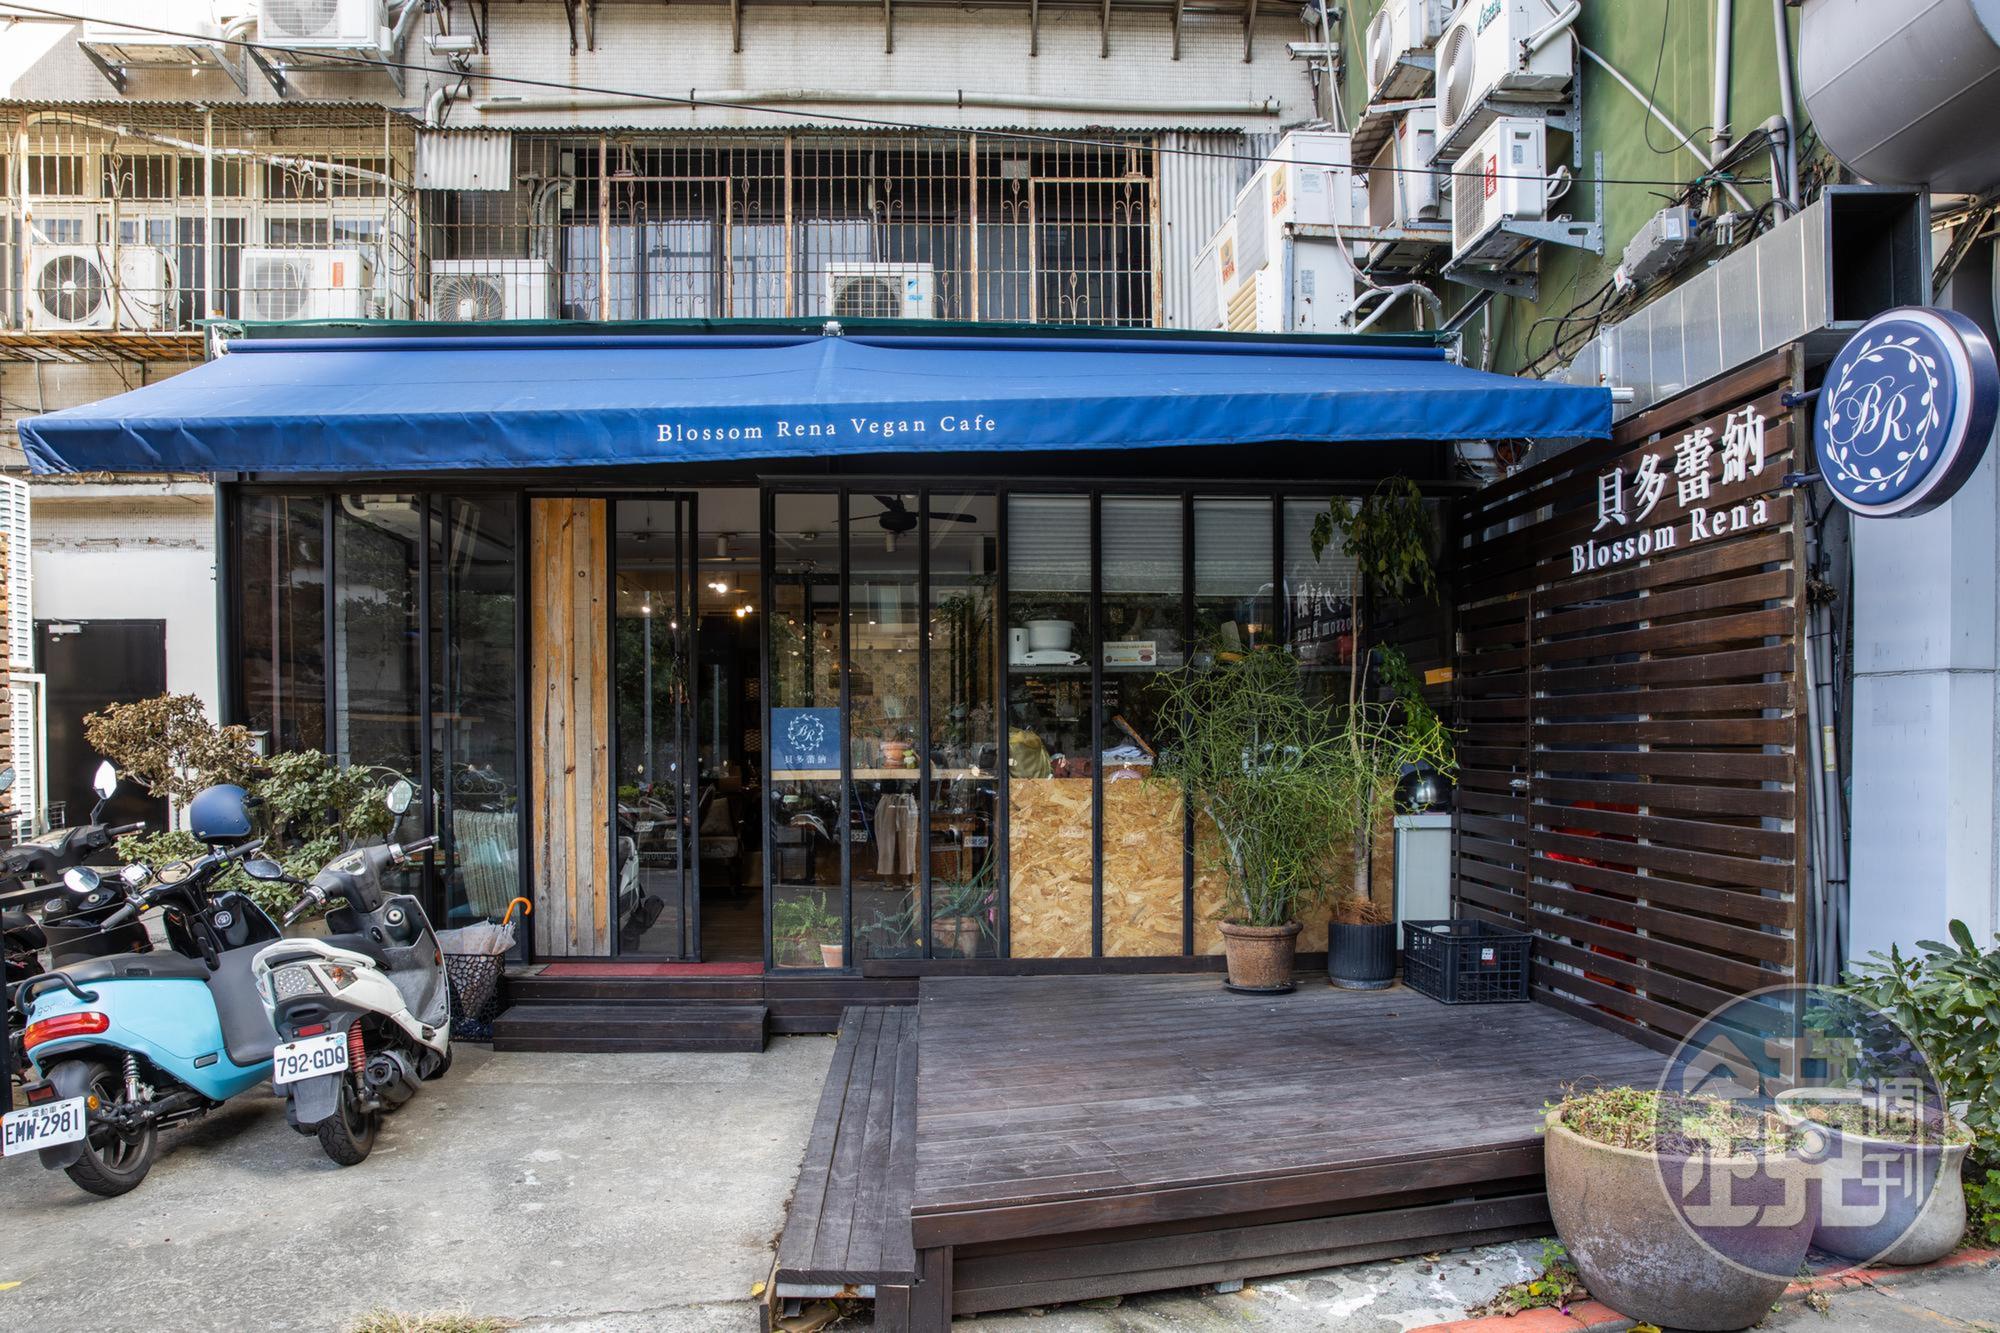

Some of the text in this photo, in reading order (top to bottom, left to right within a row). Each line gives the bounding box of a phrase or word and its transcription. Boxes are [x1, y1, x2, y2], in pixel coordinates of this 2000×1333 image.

[657, 415, 996, 442] Blossom Rena Vegan Cafe
[1592, 405, 1767, 533] 貝多蕾納
[1571, 500, 1768, 574] Blossom Rena
